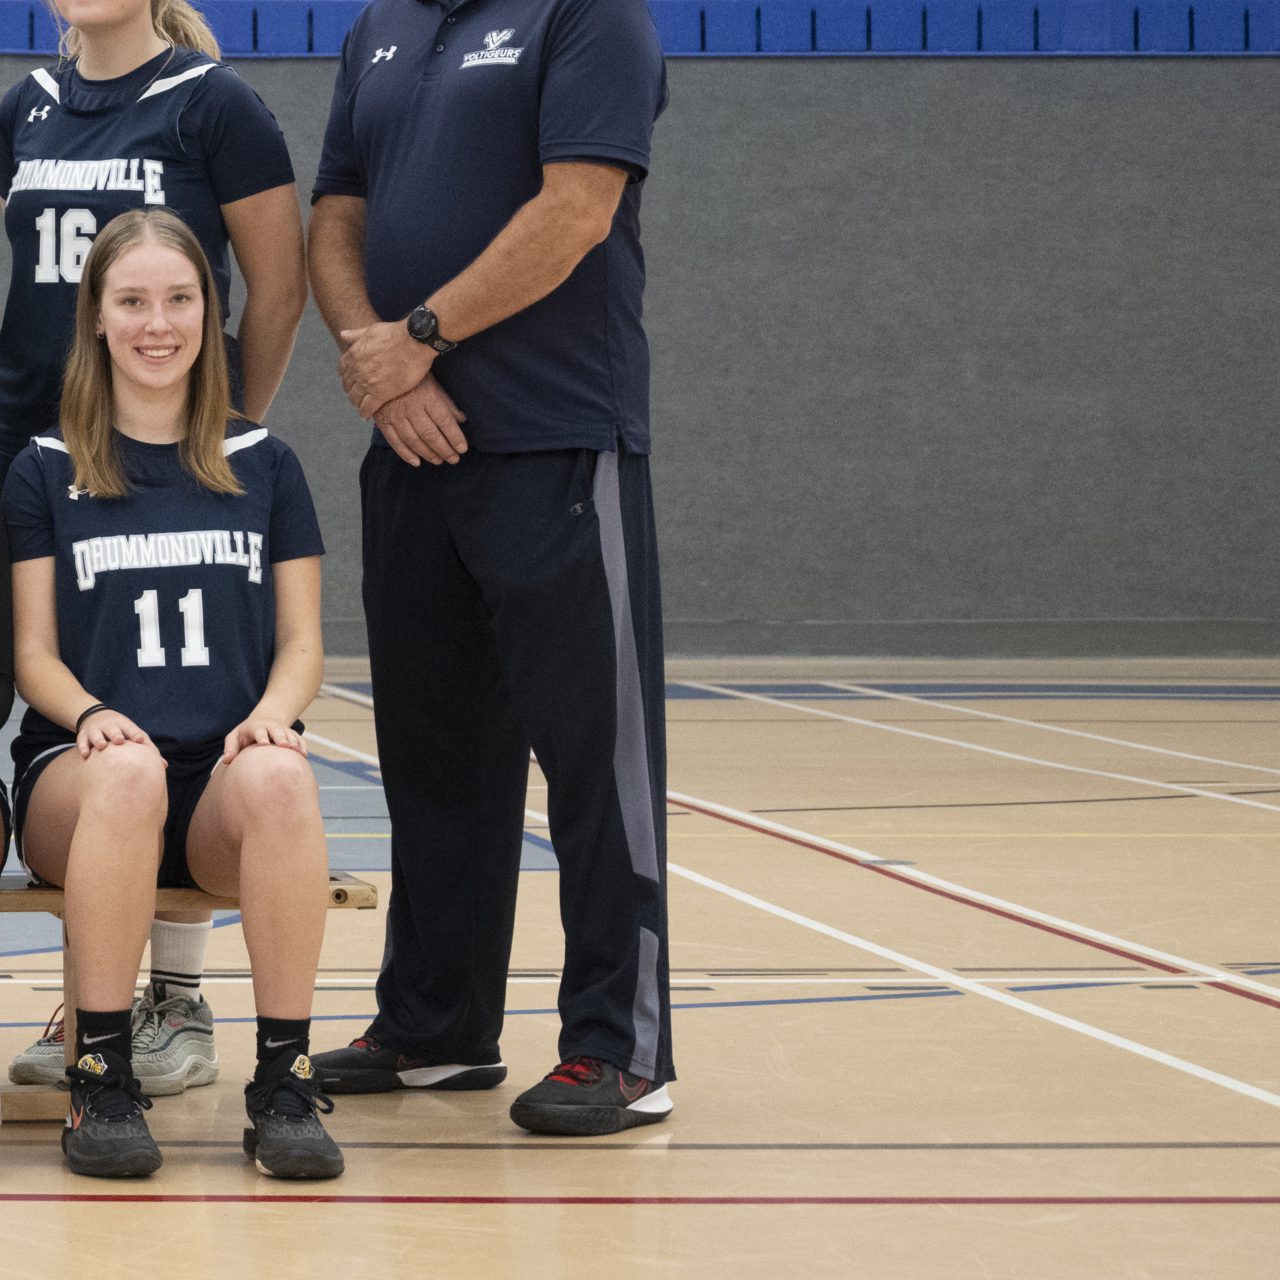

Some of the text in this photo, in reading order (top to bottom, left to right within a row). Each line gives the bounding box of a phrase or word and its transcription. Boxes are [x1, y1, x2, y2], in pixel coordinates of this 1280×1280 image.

[34, 208, 97, 283] 16
[72, 530, 264, 592] DRUMMONDVILLE
[133, 588, 209, 668] 11
